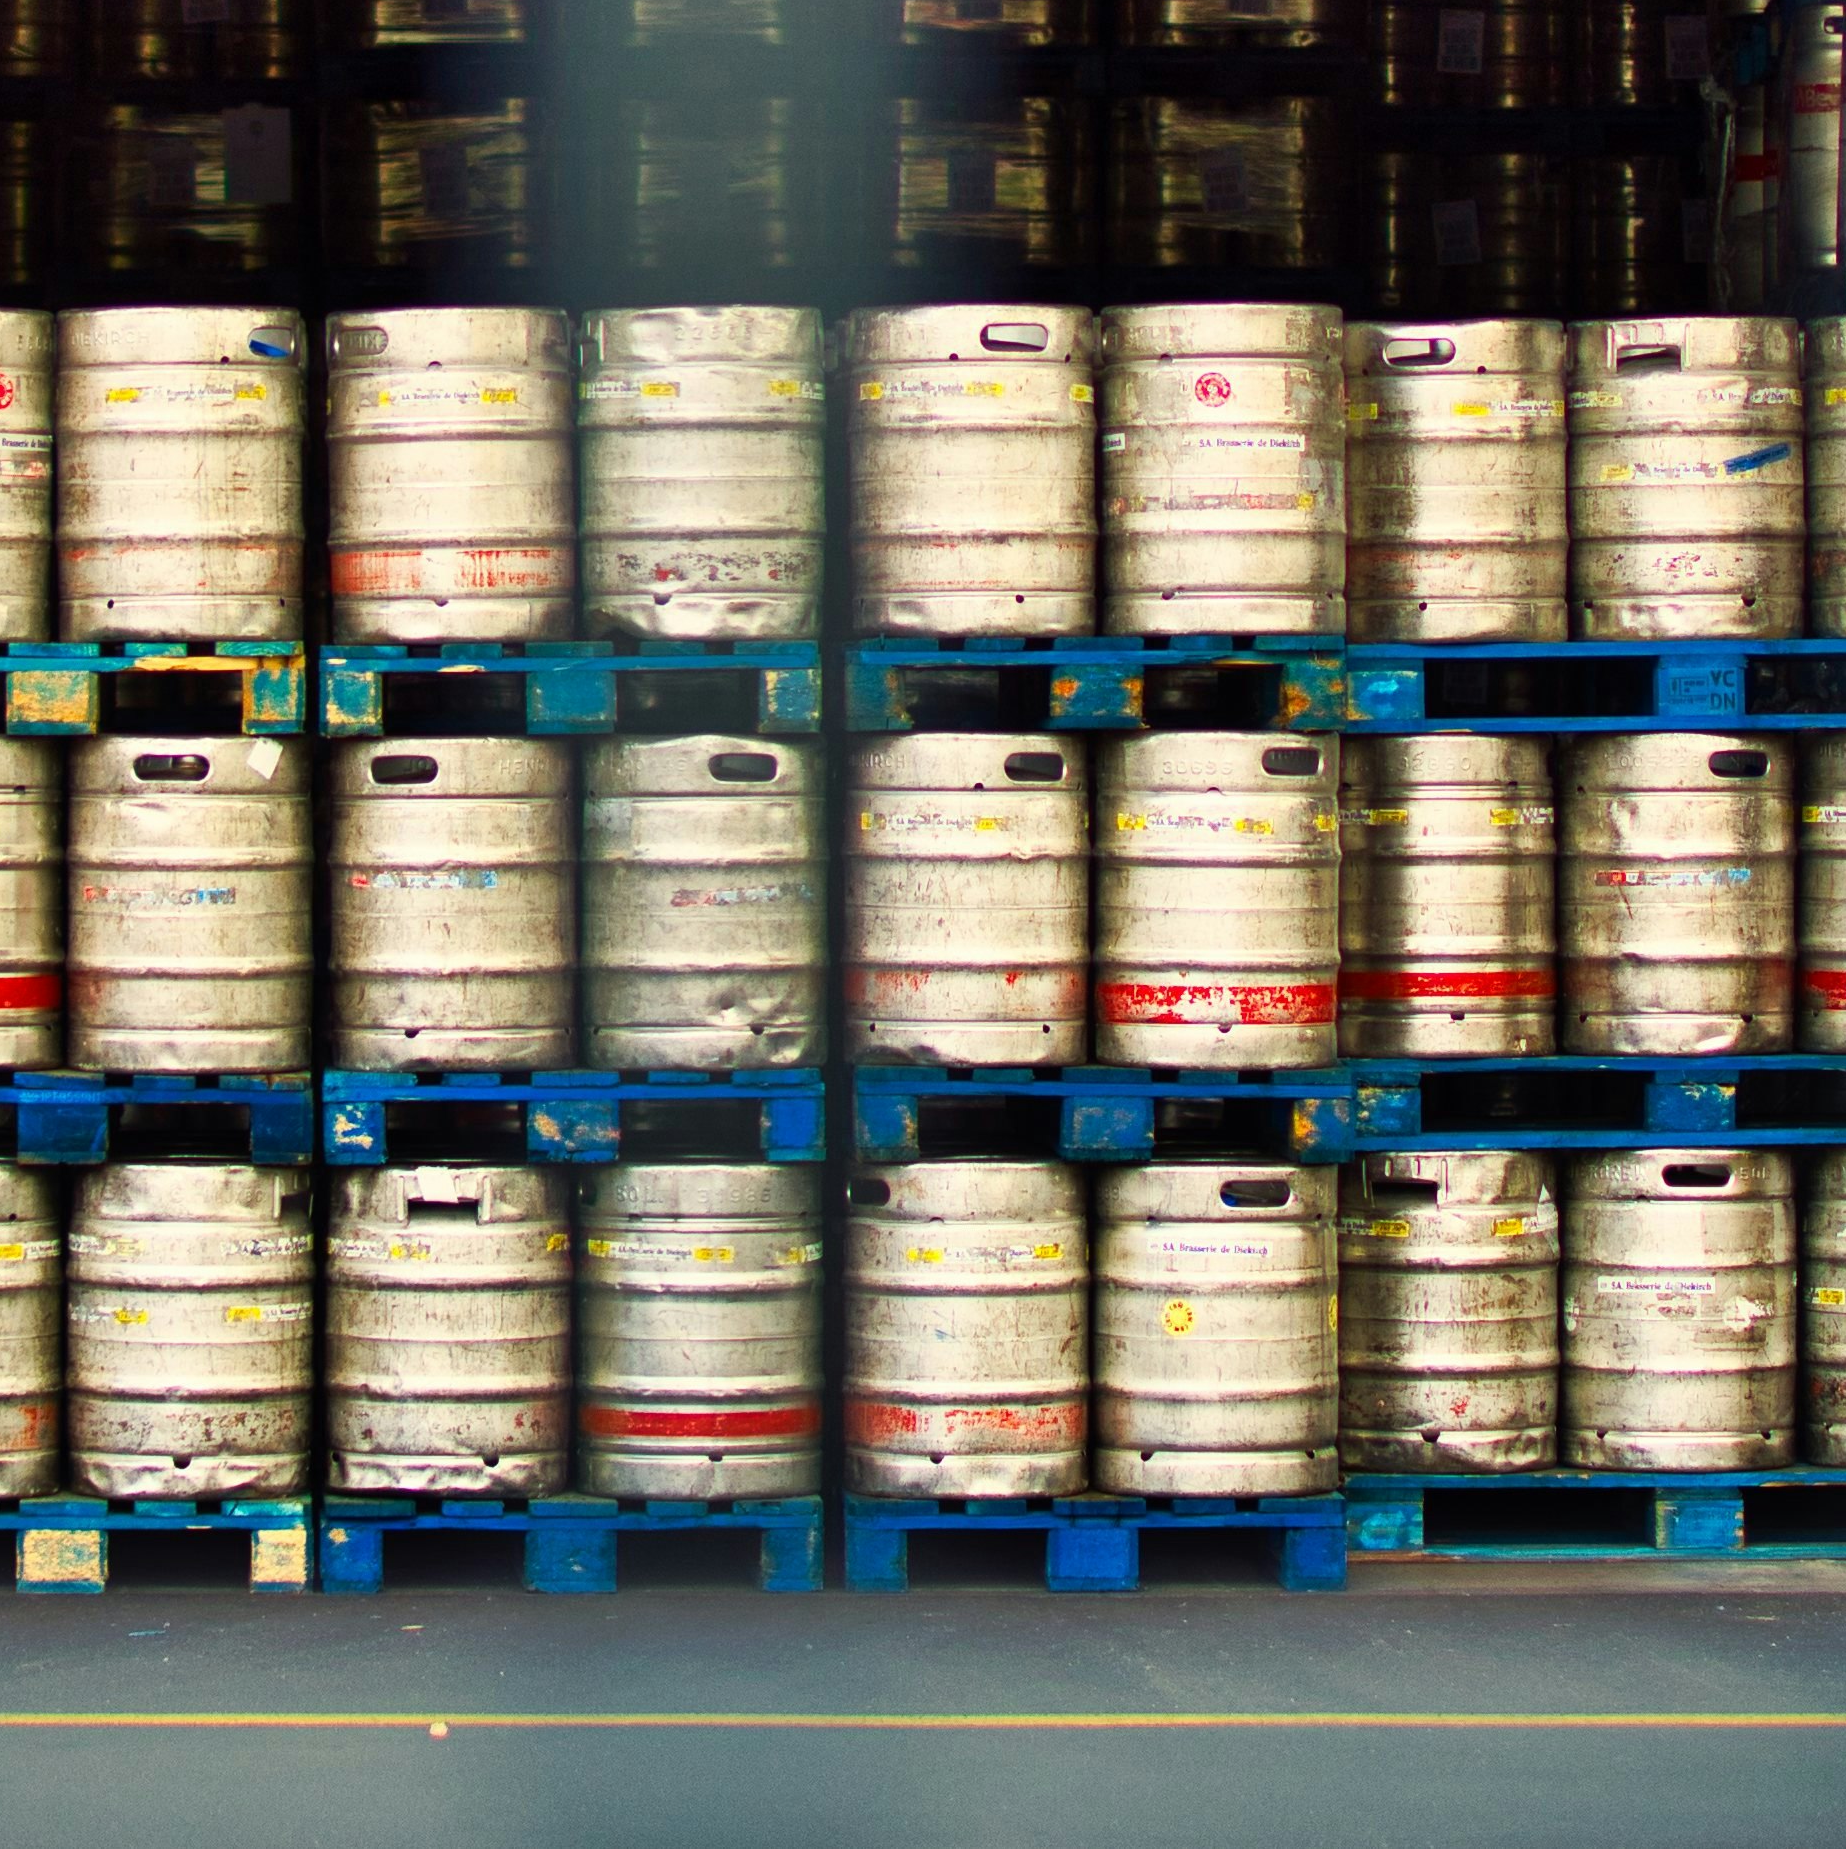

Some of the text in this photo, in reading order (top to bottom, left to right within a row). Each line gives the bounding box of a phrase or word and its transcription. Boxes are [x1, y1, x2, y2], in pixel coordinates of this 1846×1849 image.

[1257, 438, 1267, 448] de
[1710, 670, 1736, 688] VC
[1710, 693, 1736, 711] DN
[1179, 1242, 1217, 1253] Brasserie
[1220, 1244, 1230, 1254] de
[1625, 1281, 1662, 1291] Brasserie
